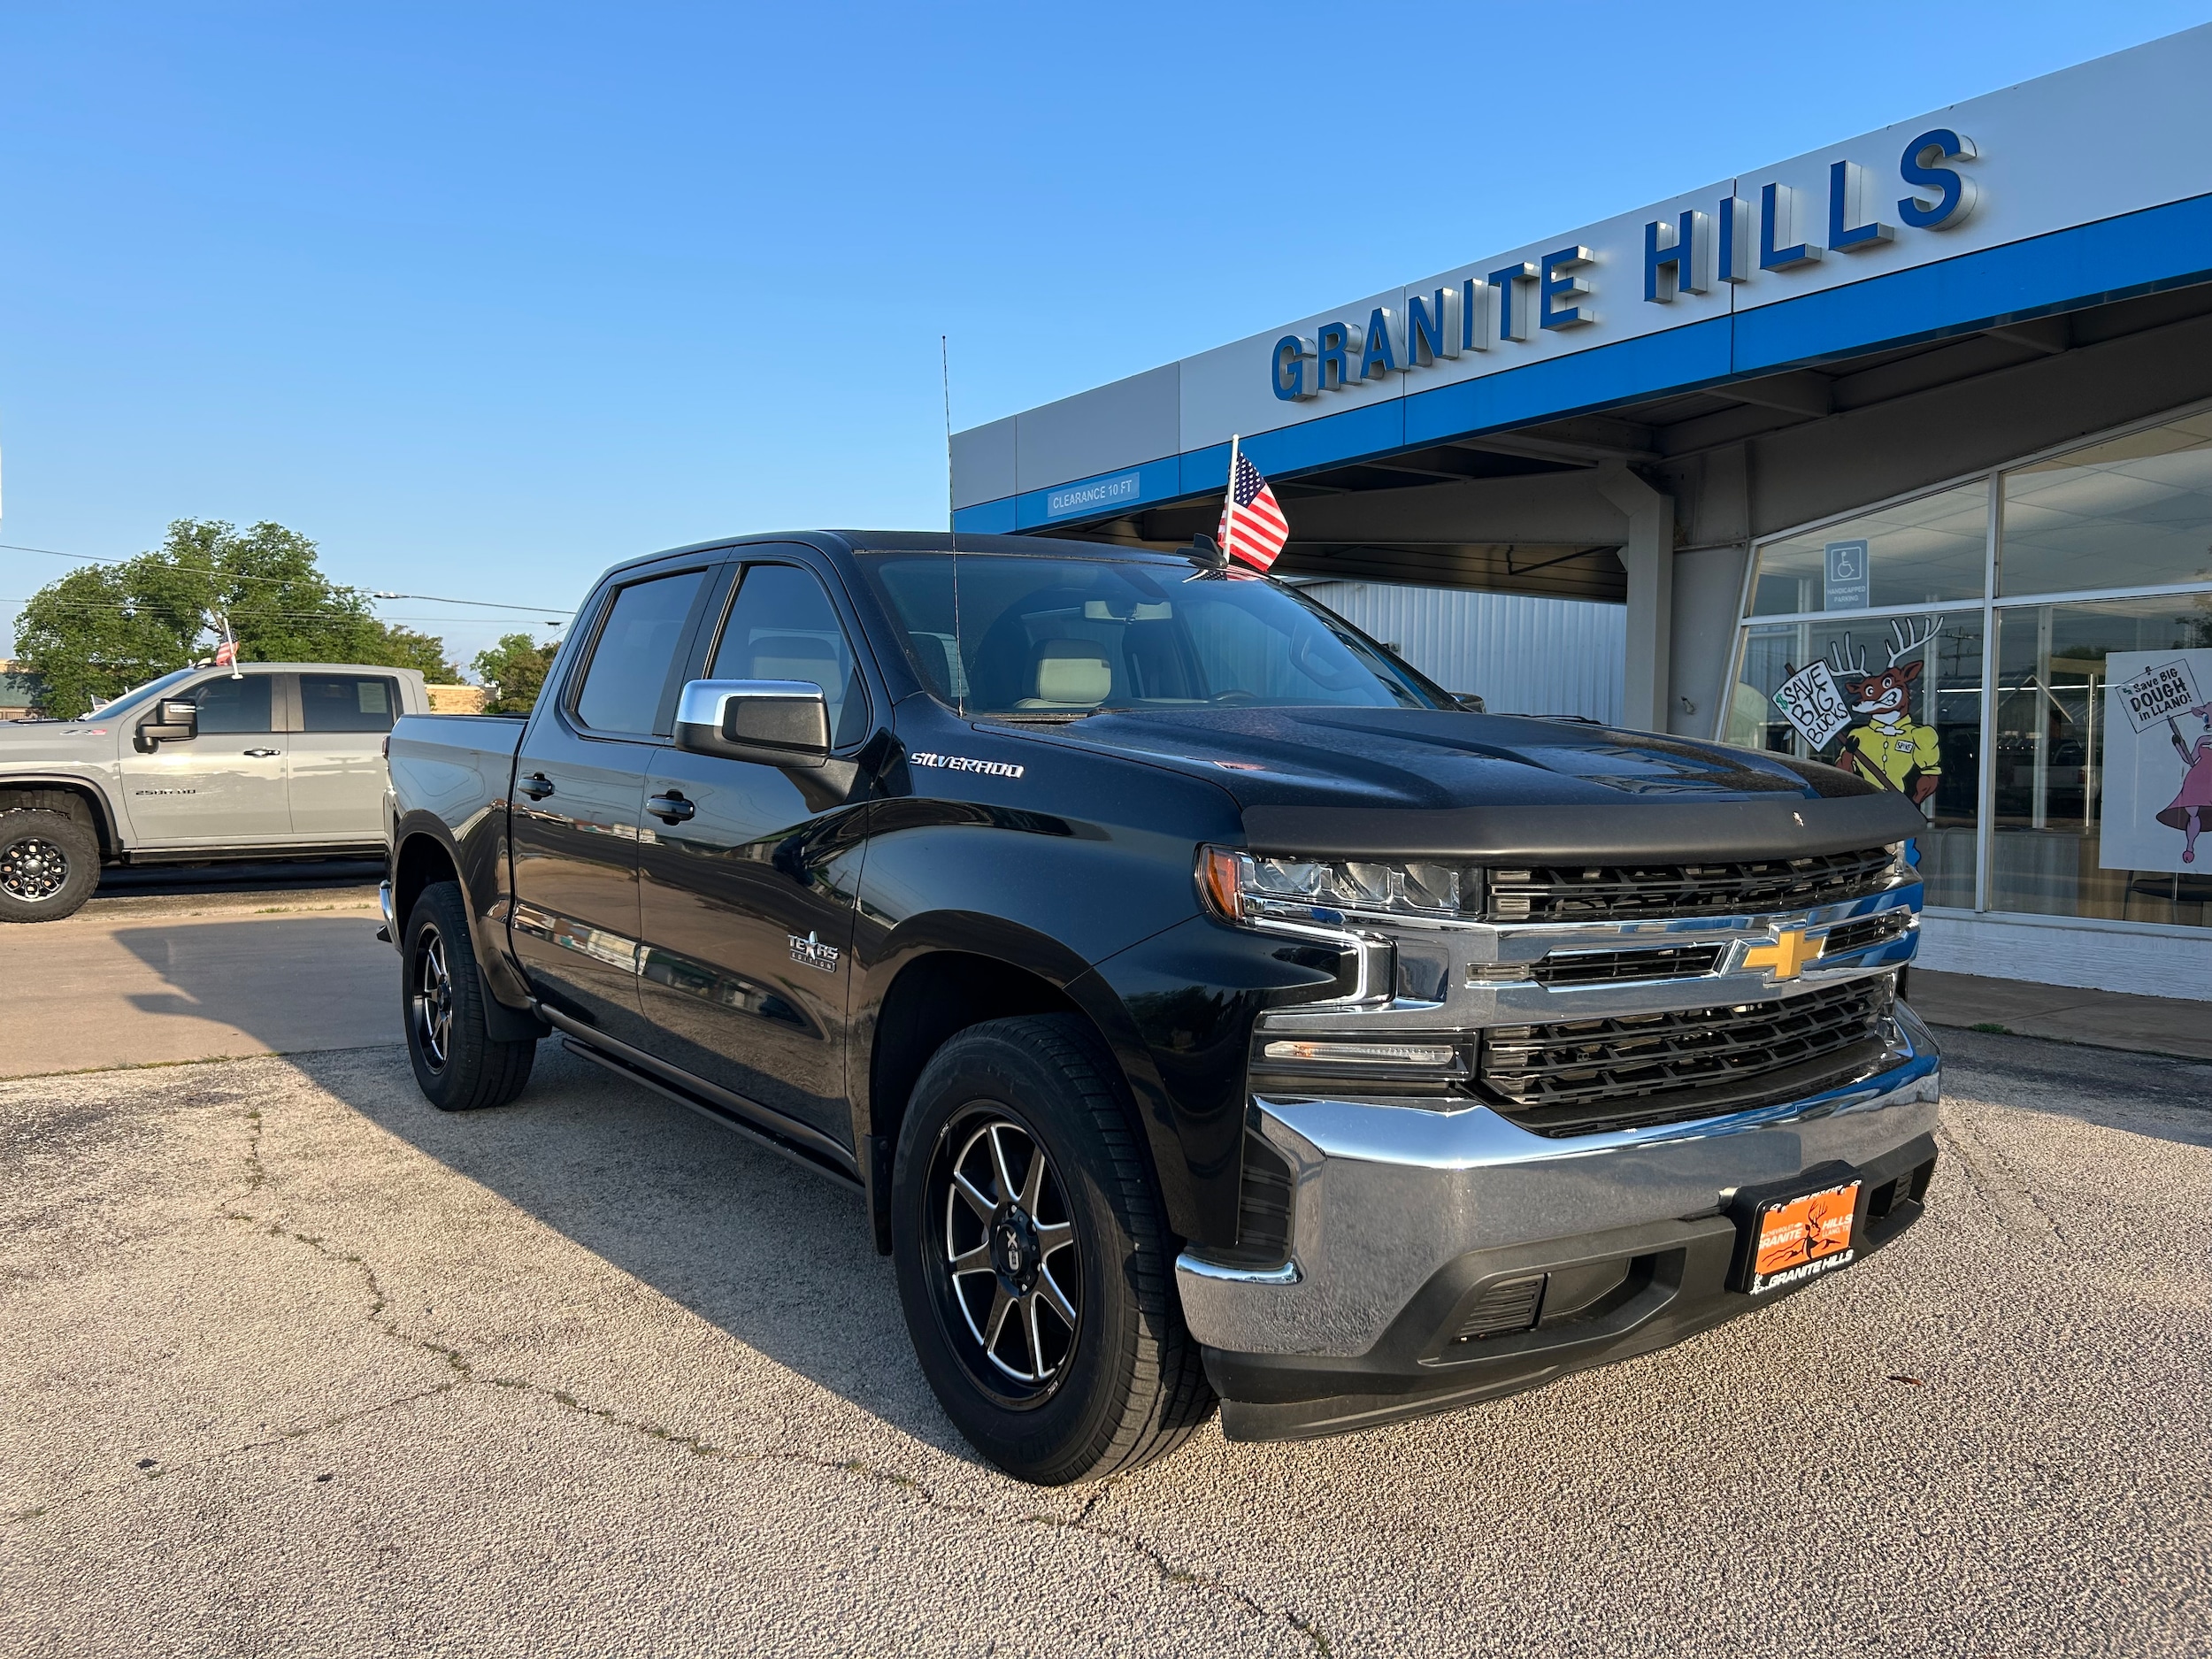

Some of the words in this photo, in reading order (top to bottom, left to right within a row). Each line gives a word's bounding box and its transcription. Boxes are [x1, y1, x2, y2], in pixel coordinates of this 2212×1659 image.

[1271, 245, 1594, 402] GRANITE
[1644, 128, 1978, 303] HILLS
[1053, 486, 1106, 510] CLEARANCE
[1108, 483, 1118, 496] 10
[1120, 480, 1133, 495] FT
[1827, 585, 1866, 595] HANDICAPPED
[2130, 677, 2187, 712] DOUGH
[2133, 678, 2159, 693] Save
[2160, 668, 2178, 682] BIG
[1792, 687, 1834, 726] BIG
[2138, 711, 2151, 721] in
[2151, 692, 2193, 717] LLANO!
[1806, 702, 1848, 744] BUCKS
[1897, 741, 1912, 750] SPIKE
[910, 752, 1025, 779] SILVERADO
[792, 952, 832, 970] EDITION
[1765, 1224, 1794, 1237] CHEVROLET
[1823, 1213, 1853, 1230] HILLS
[1769, 1263, 1821, 1288] GRANITE
[1822, 1248, 1855, 1270] HILLS
